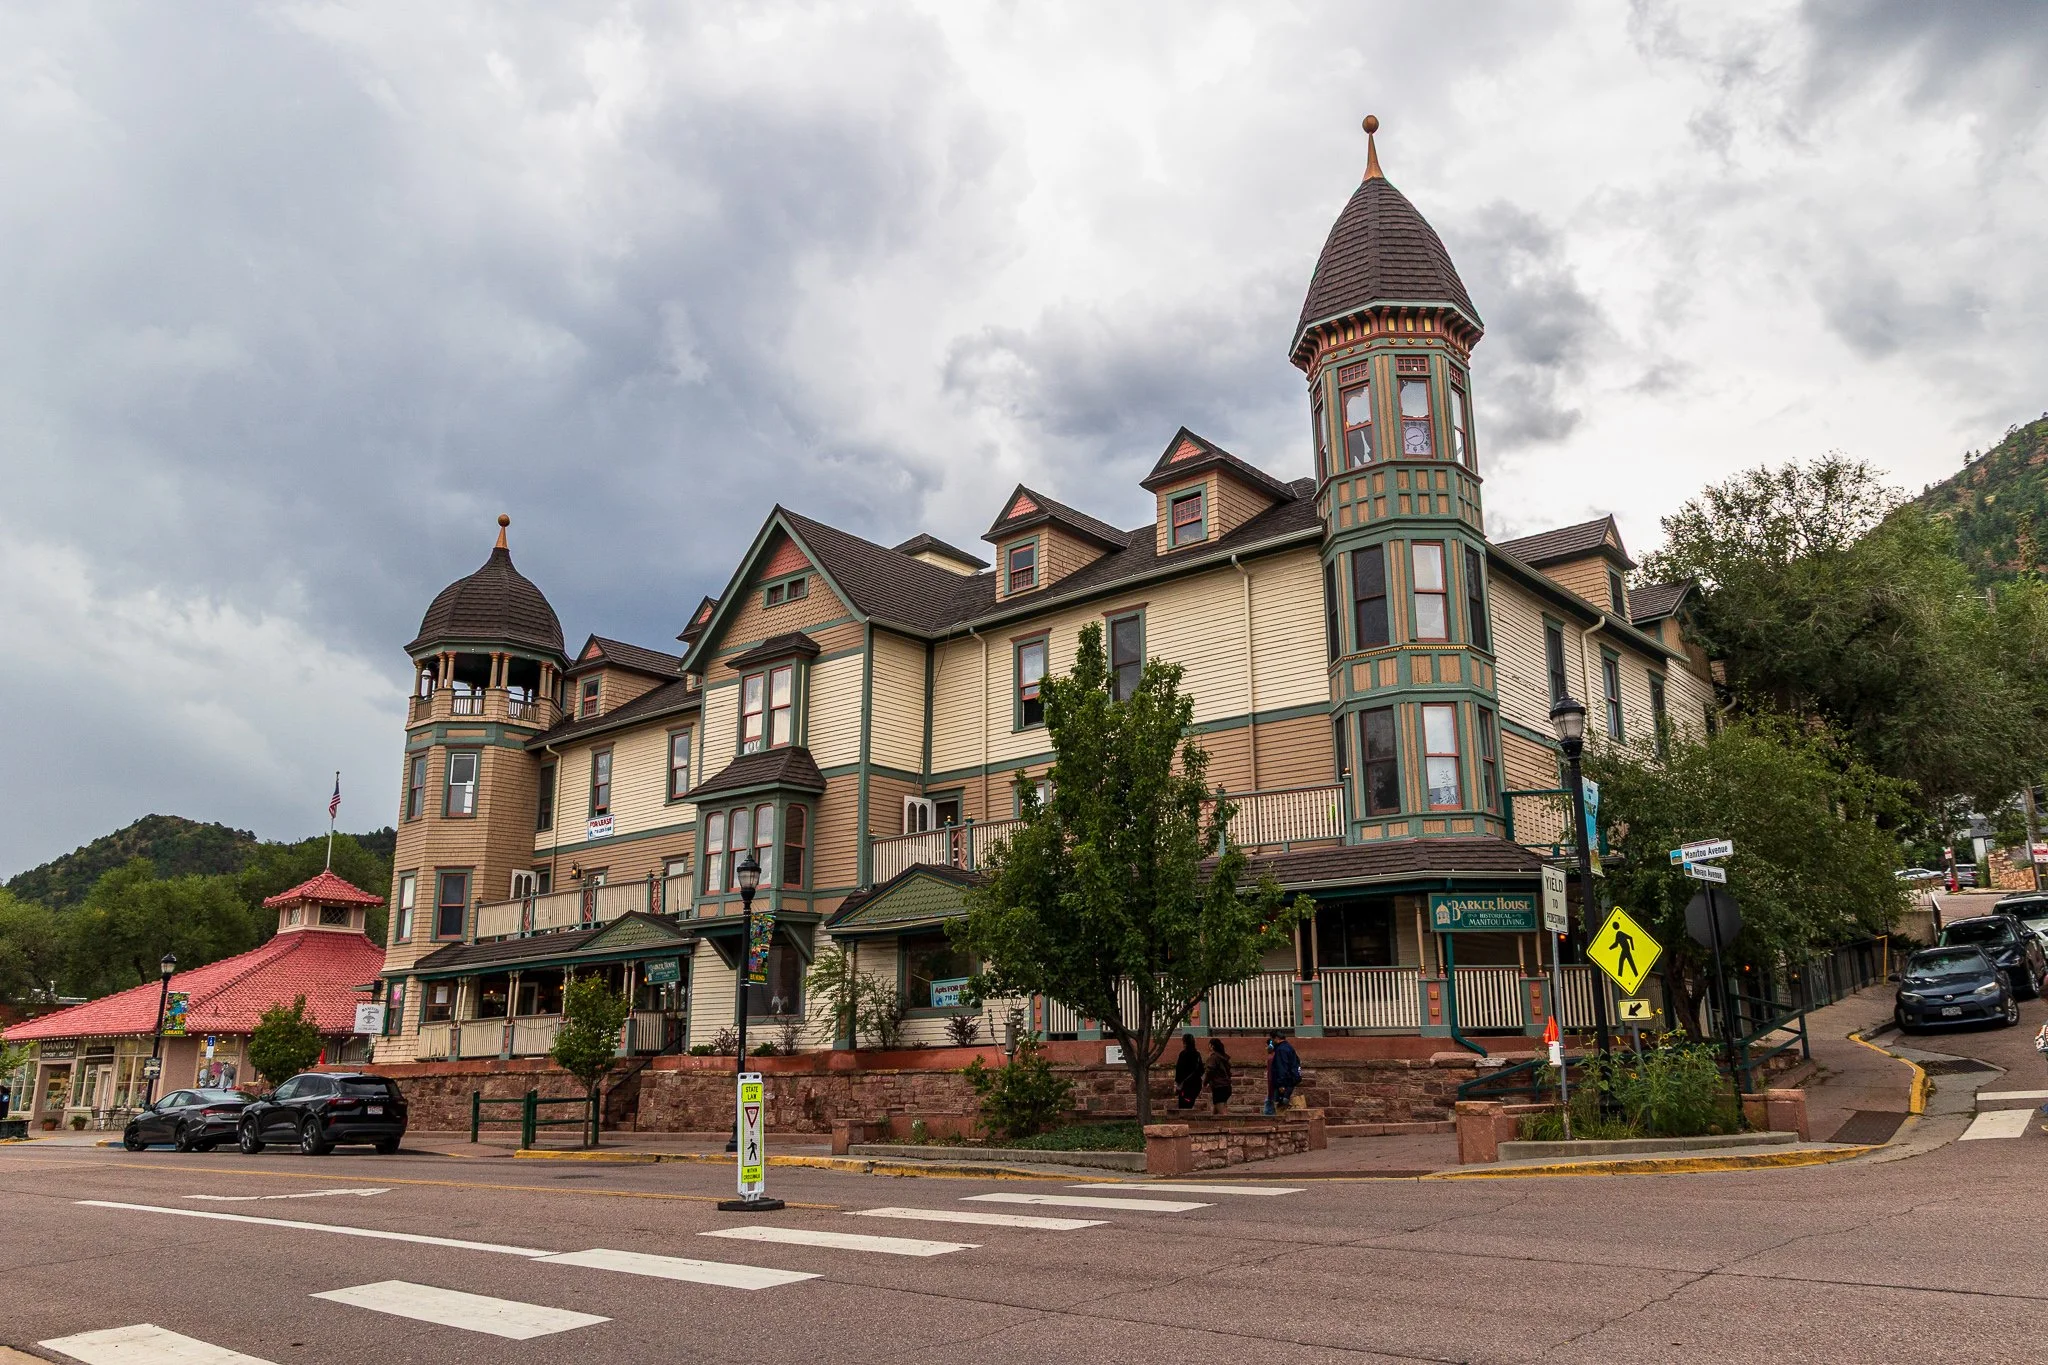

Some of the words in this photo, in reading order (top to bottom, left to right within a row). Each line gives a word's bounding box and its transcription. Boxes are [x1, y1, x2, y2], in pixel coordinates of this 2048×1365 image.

[599, 817, 612, 827] LEASE
[1684, 849, 1707, 860] Manitou
[1708, 845, 1728, 856] Avenue
[1707, 869, 1723, 880] Avenue
[1545, 875, 1564, 893] YIELD
[1452, 900, 1496, 921] BARKER
[1497, 897, 1532, 910] HOUSE
[1552, 898, 1559, 909] TO
[1469, 918, 1500, 926] MANITOU
[1502, 918, 1525, 926] LIVING
[42, 1041, 76, 1051] MANITOU
